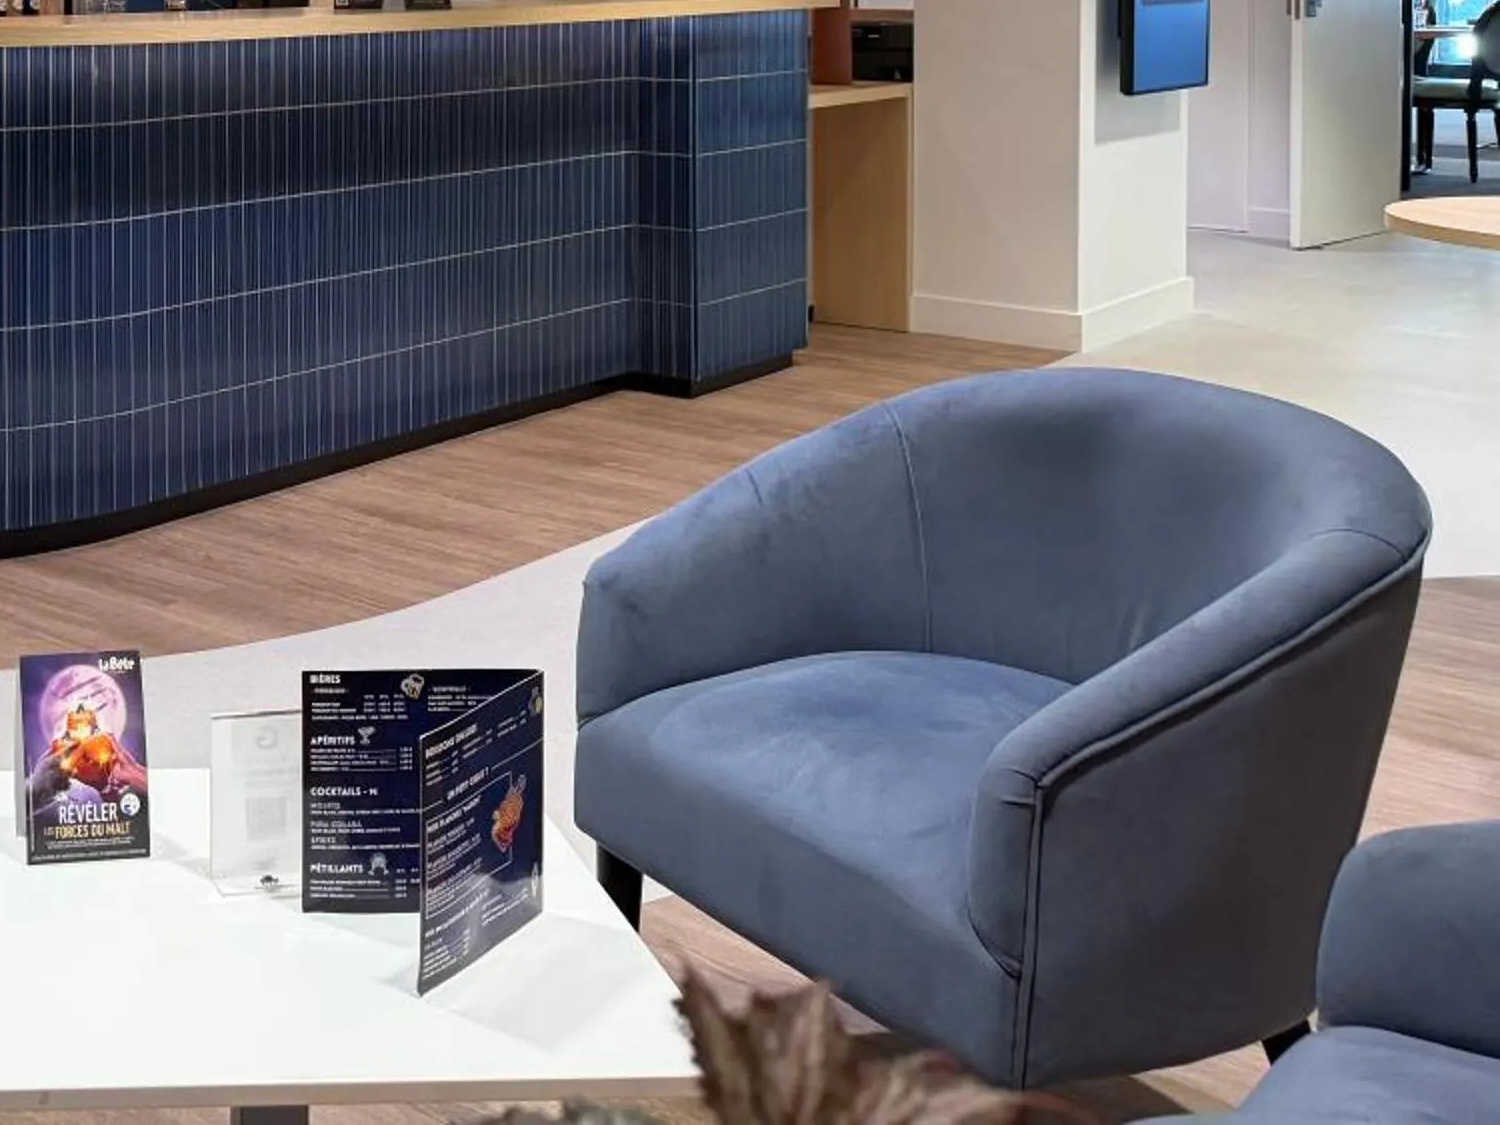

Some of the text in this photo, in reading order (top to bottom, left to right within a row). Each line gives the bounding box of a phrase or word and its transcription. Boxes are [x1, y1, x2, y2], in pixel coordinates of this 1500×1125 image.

[310, 734, 356, 746] APÉRITIFS
[310, 787, 361, 796] COCKTAILS
[58, 800, 118, 824] RÉVÉLER
[55, 825, 89, 840] FORCES
[91, 824, 105, 837] DU
[310, 862, 364, 874] PÉTILLANTS
